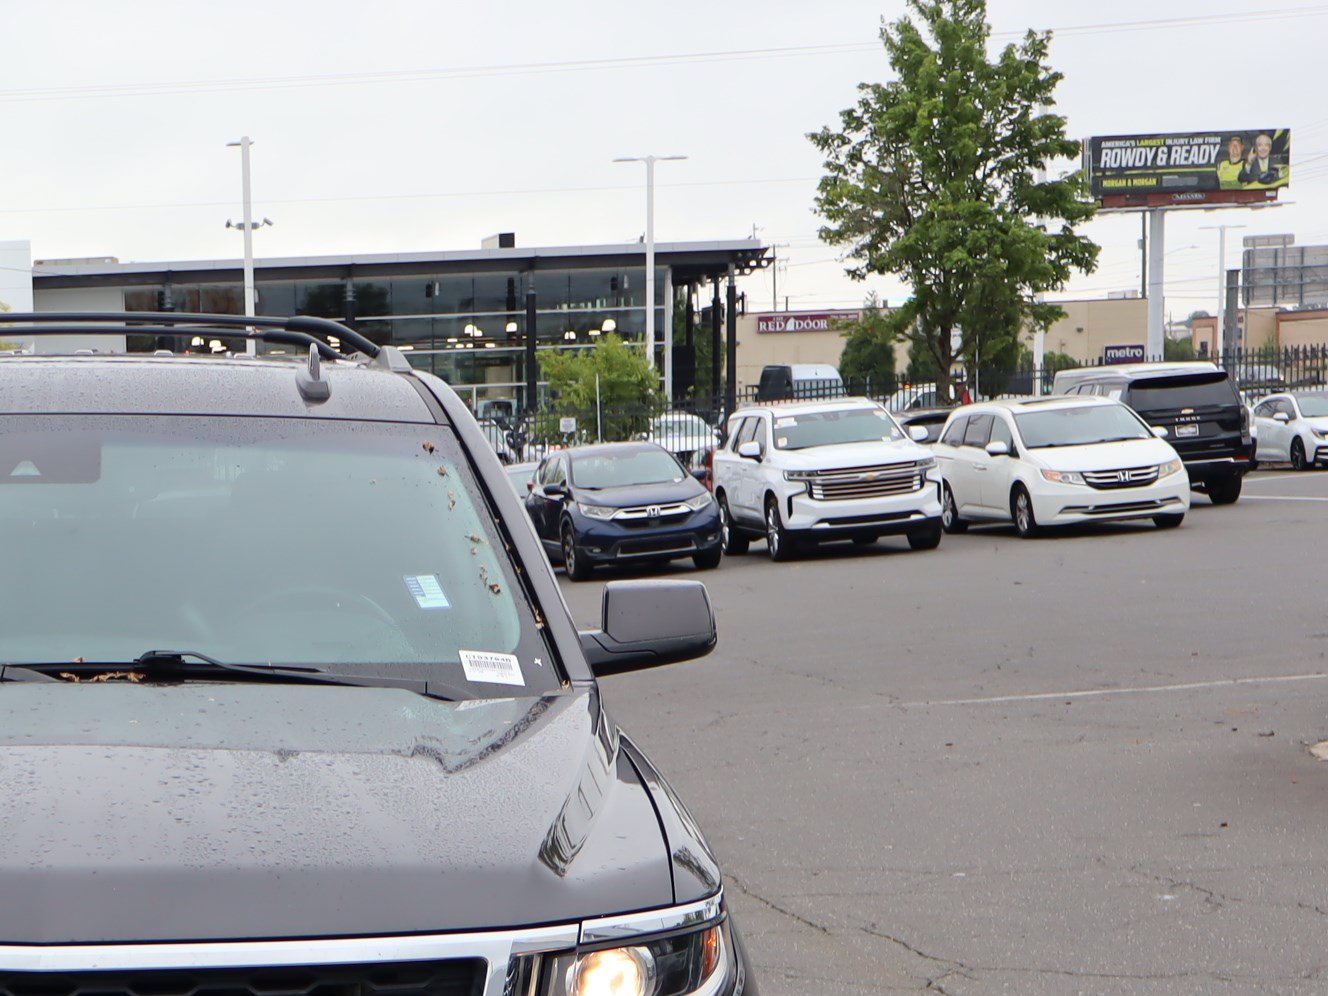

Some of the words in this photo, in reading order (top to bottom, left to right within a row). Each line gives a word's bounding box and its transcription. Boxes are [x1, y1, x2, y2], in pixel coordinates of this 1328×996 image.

[1136, 138, 1165, 147] LARGEST
[1165, 137, 1189, 146] INJURY
[1189, 137, 1204, 145] LAW
[1204, 136, 1221, 144] FIRM
[1100, 146, 1157, 169] ROWDY
[1156, 146, 1169, 166] &
[1169, 144, 1221, 166] READY
[1102, 179, 1127, 188] MORGAN
[1132, 177, 1157, 187] MORGAN
[759, 321, 785, 332] RED
[795, 319, 828, 330] DOOR
[1106, 347, 1143, 359] metro
